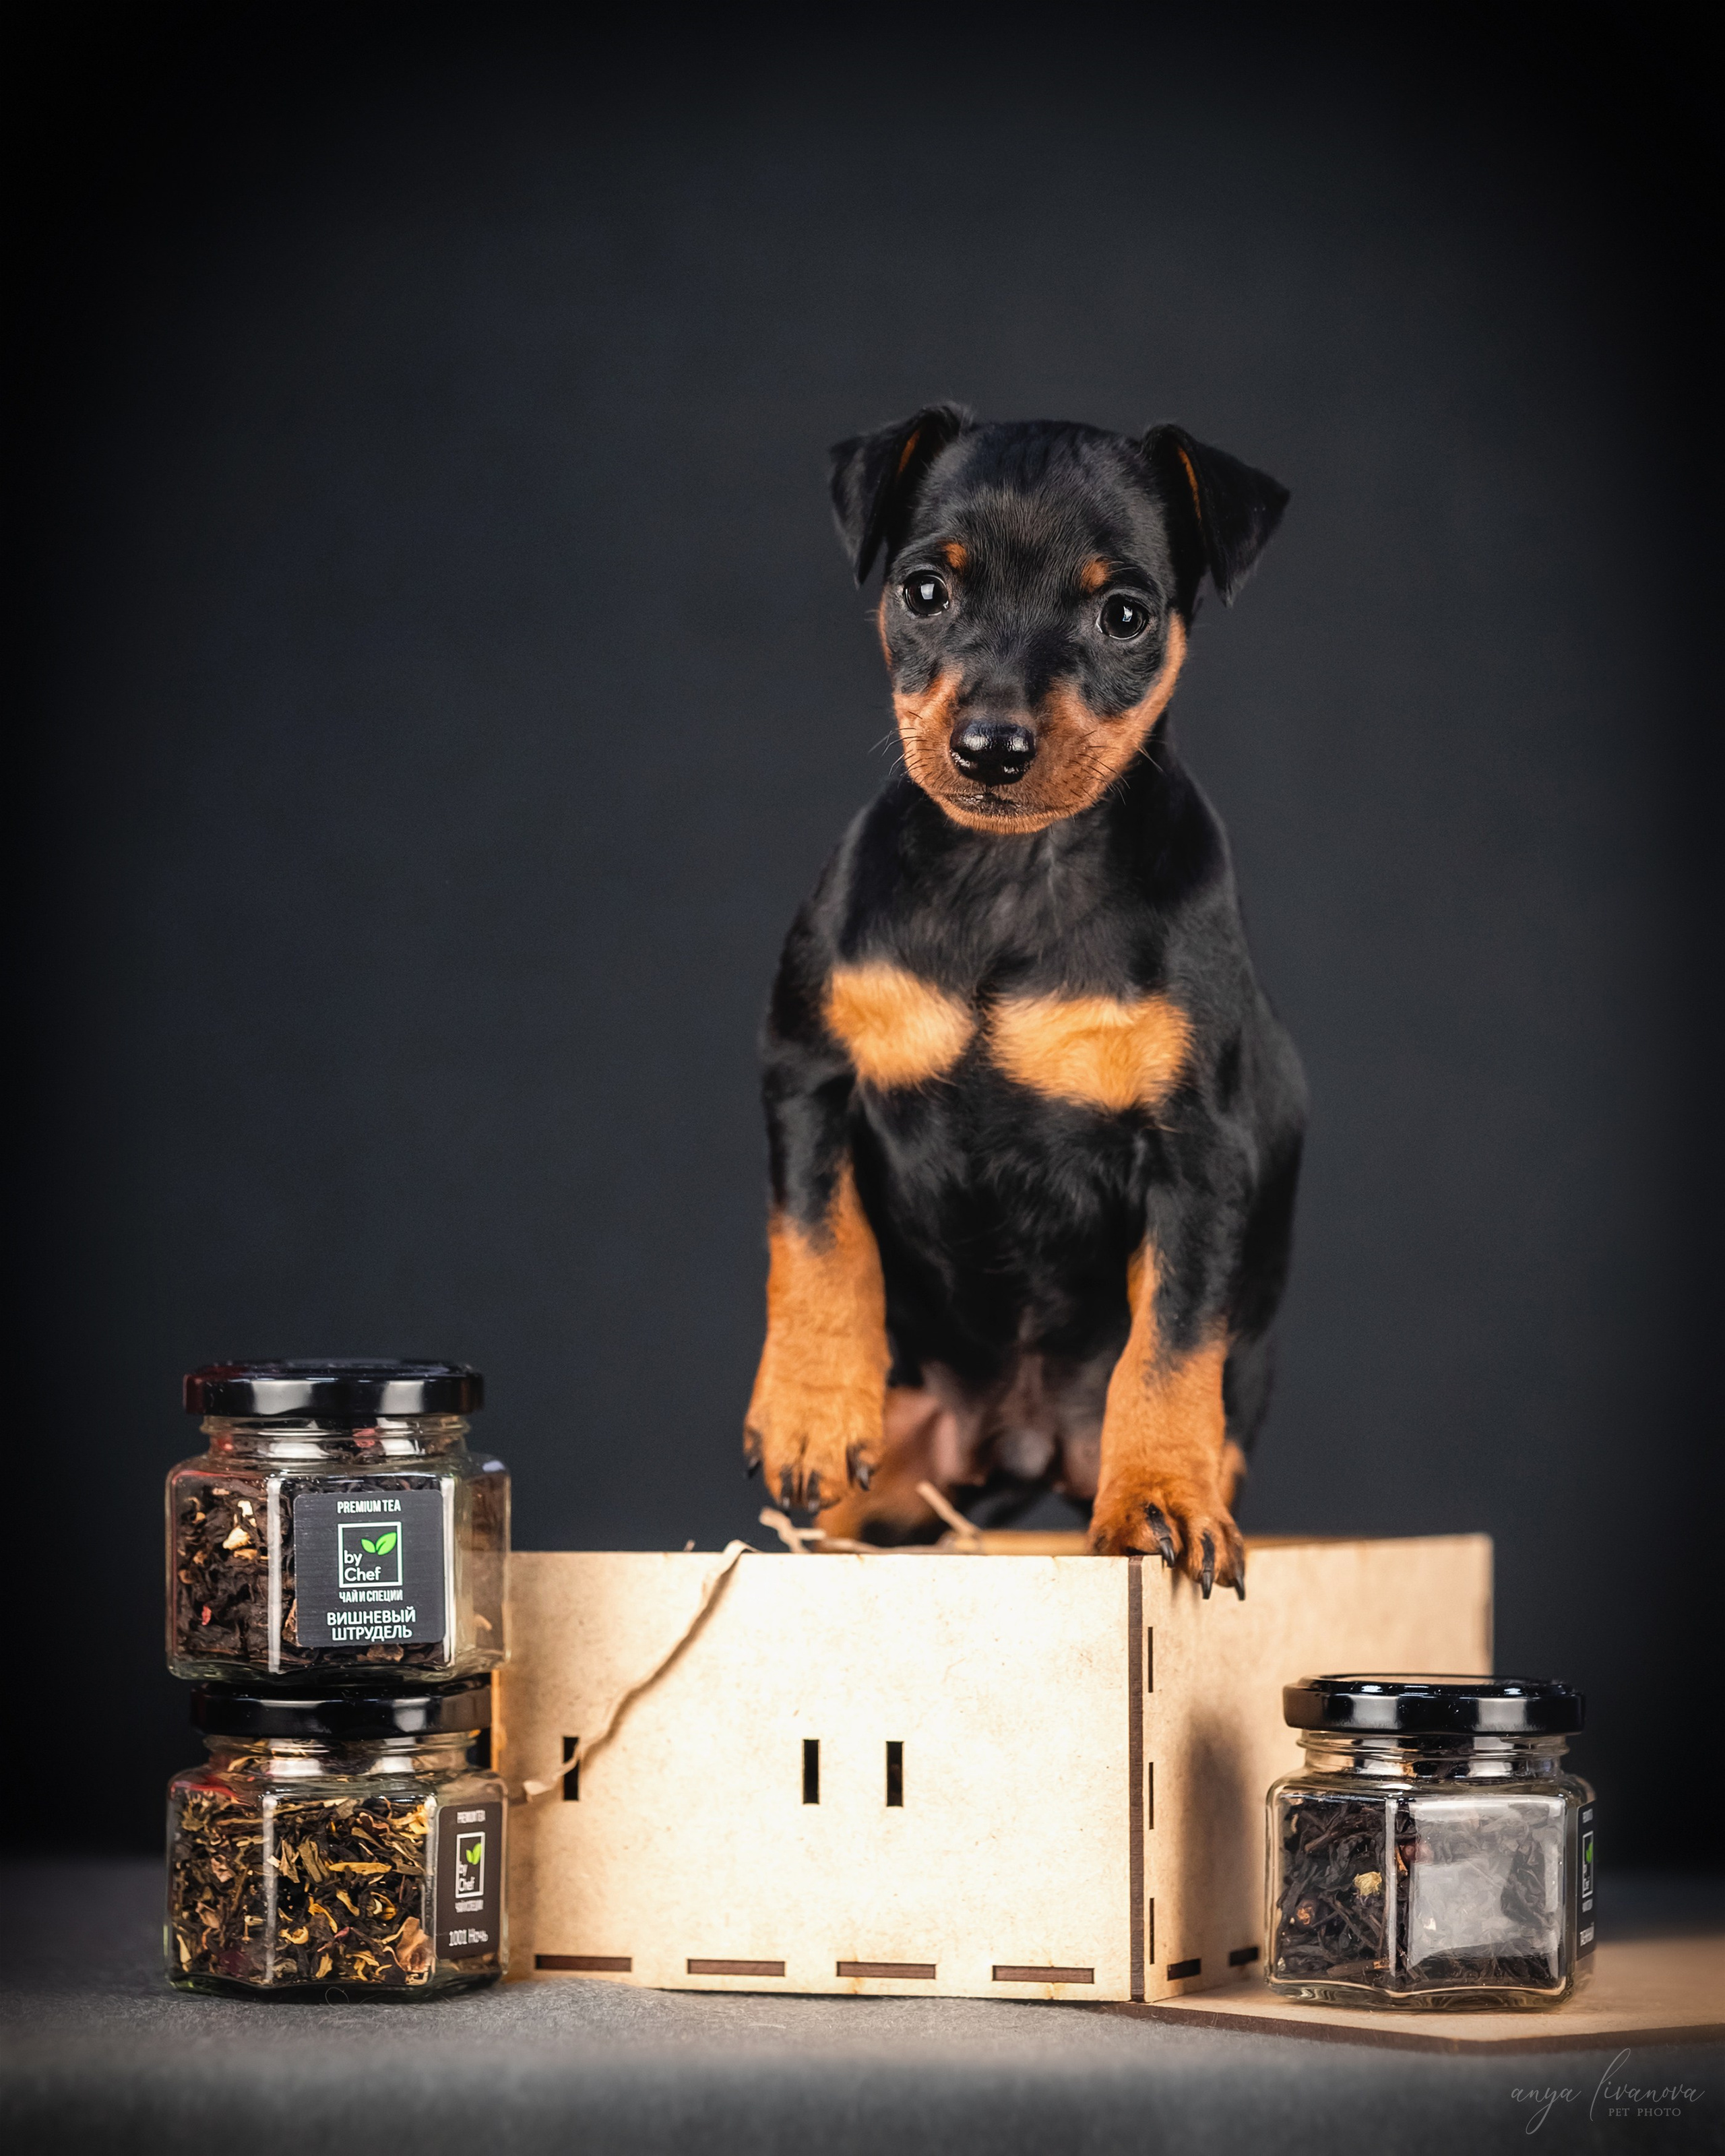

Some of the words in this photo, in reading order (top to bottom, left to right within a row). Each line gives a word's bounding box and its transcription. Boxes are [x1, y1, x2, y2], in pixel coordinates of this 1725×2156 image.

[337, 1500, 381, 1513] PREMIUM
[381, 1499, 401, 1512] TEA
[344, 1550, 363, 1566] by
[344, 1566, 381, 1581] Chef
[339, 1590, 358, 1603] ЧАЙ
[358, 1591, 365, 1602] И
[366, 1589, 403, 1602] СПЕЦИИ
[327, 1606, 416, 1626] ВИШНЕВЫЙ
[332, 1624, 412, 1642] ШТРУДЕЛЬ
[449, 1929, 468, 1946] 1001
